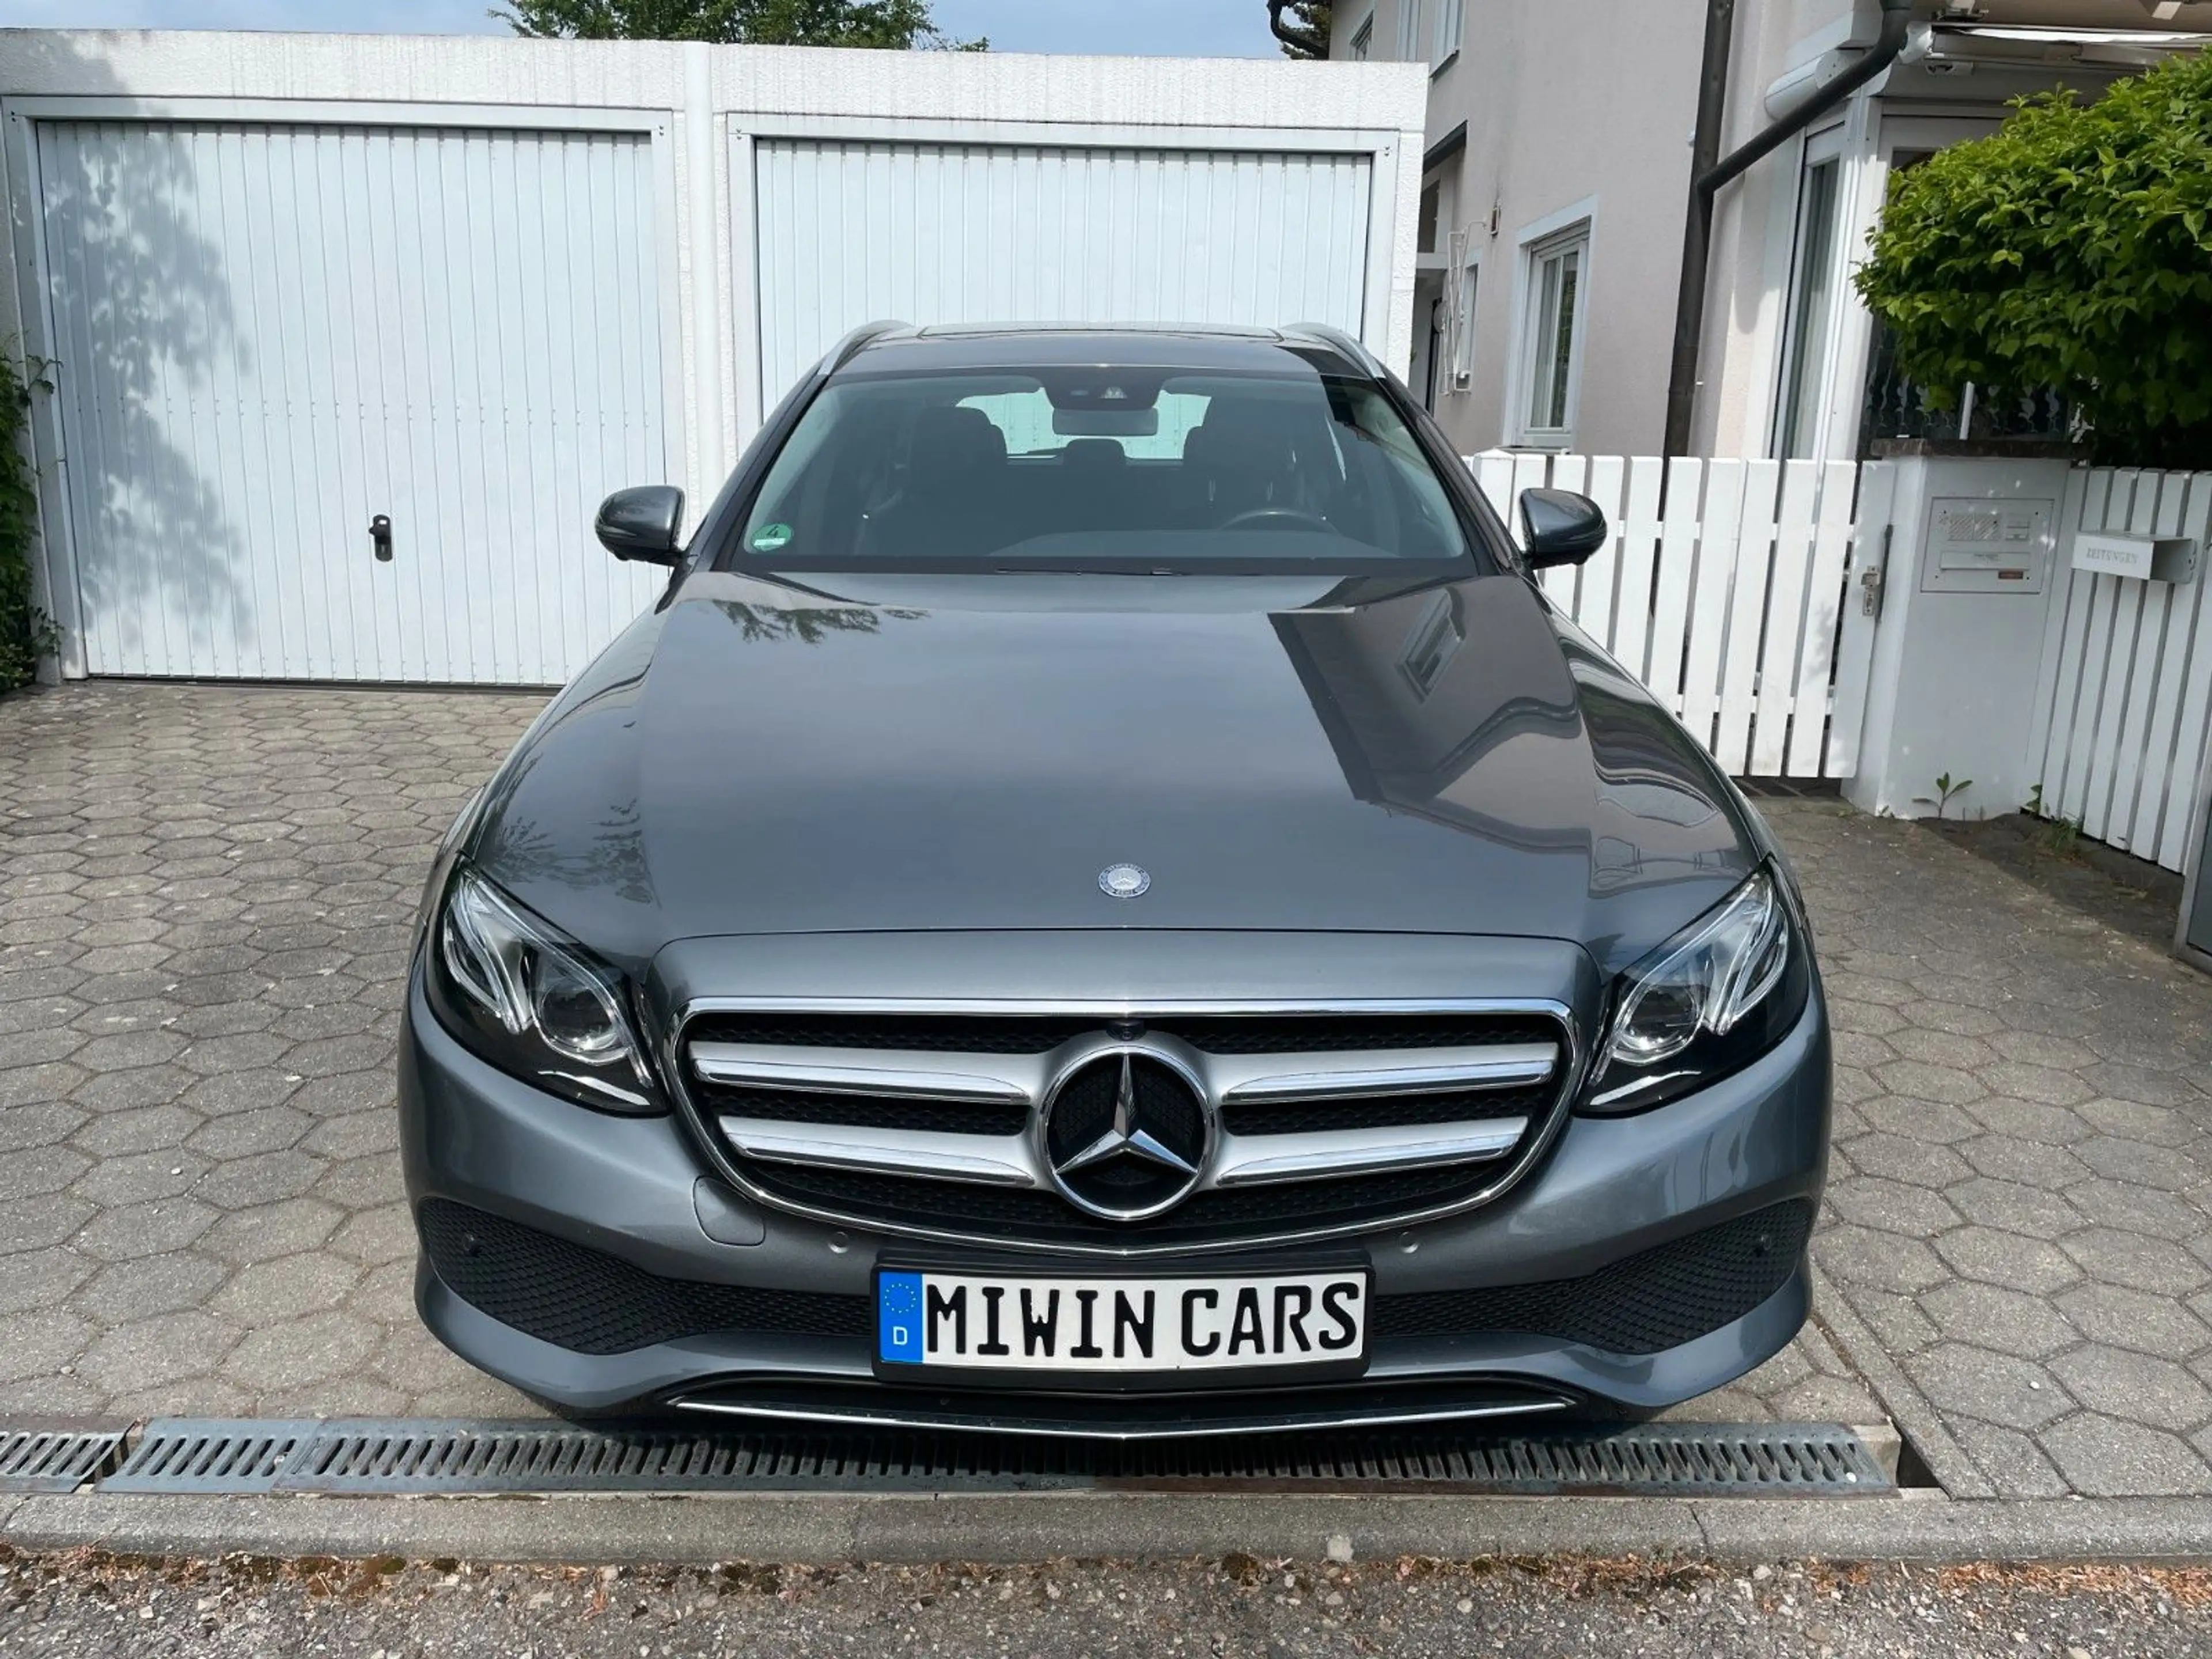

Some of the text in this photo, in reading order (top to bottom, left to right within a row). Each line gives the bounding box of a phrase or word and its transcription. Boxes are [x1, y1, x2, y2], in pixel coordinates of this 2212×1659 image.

[766, 525, 779, 537] 4
[927, 1282, 1359, 1358] MIWIN CARS
[893, 1326, 908, 1345] D
